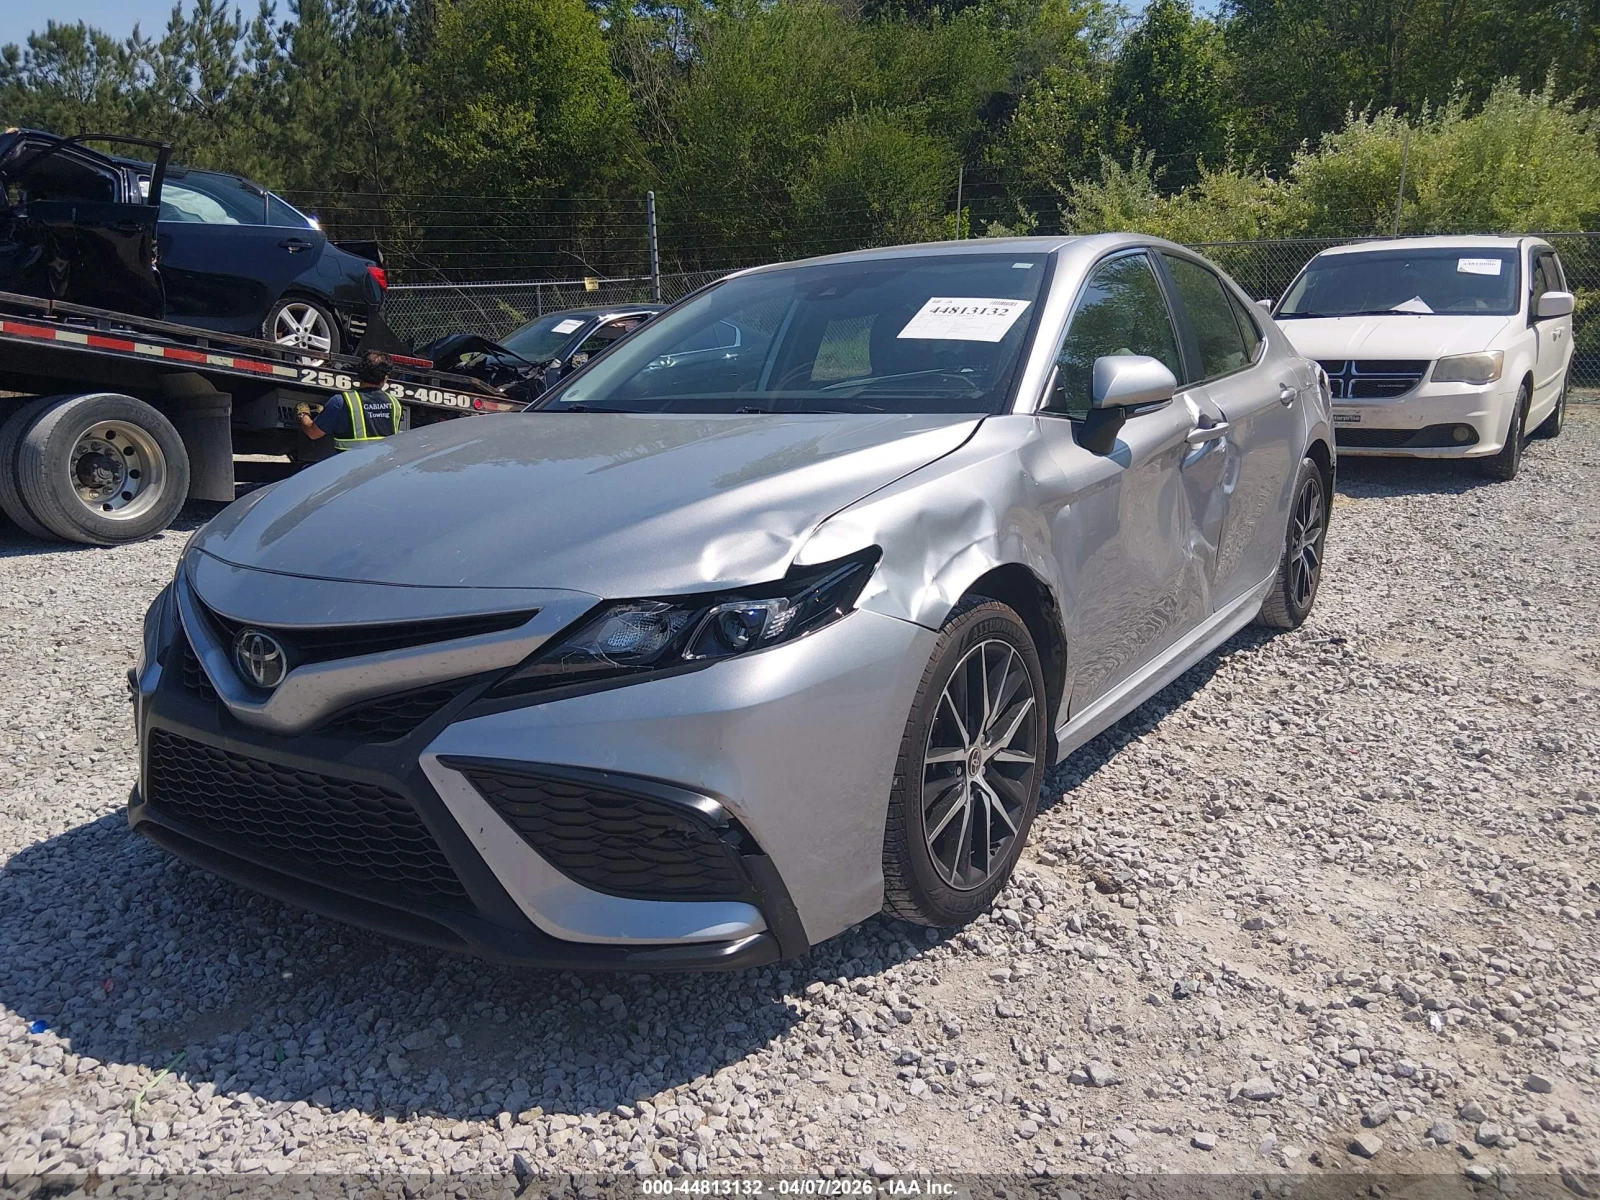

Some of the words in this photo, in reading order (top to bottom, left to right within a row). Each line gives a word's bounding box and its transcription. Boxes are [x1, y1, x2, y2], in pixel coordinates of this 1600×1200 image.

[929, 306, 1009, 316] 44813132
[301, 369, 471, 408] 256-3-4050
[367, 411, 391, 419] Towing
